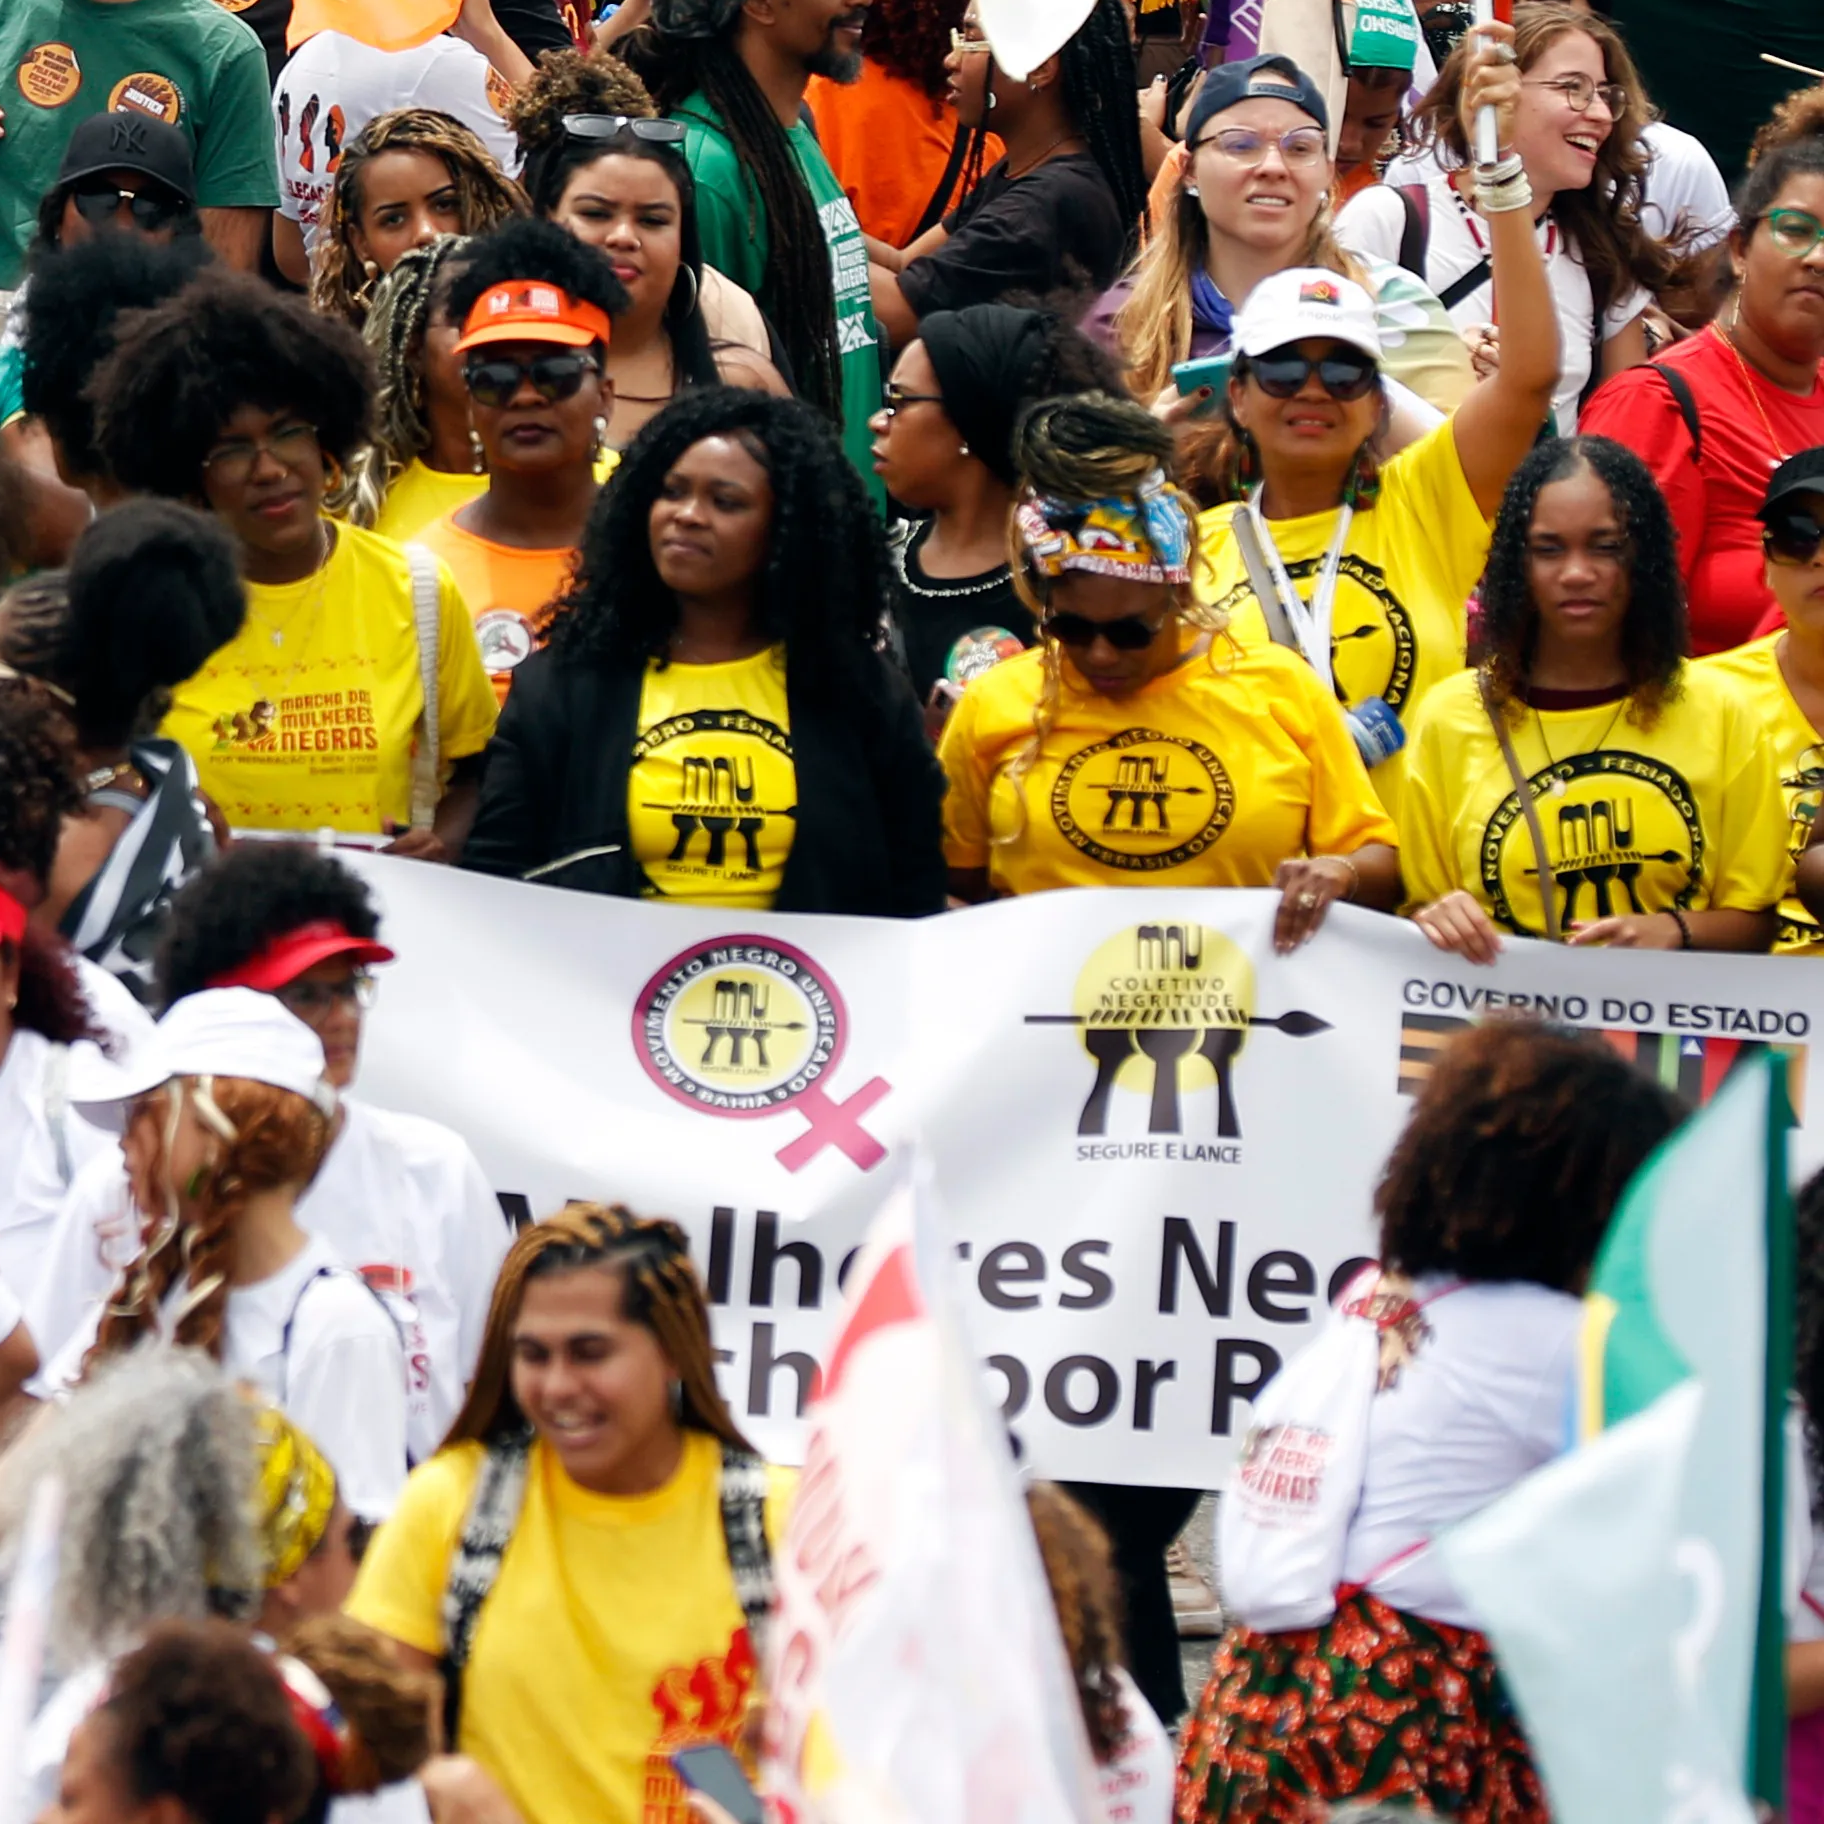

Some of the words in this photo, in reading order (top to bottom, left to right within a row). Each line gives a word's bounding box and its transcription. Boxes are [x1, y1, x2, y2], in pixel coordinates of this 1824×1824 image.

[281, 691, 344, 712] MARCHA
[280, 705, 374, 731] MULHERES
[281, 722, 381, 753] NEGRAS
[1600, 755, 1696, 820] FERIADO
[1187, 748, 1234, 855] UNIFICADO
[1101, 850, 1178, 871] BRASIL
[1108, 976, 1228, 995] COLETIVO
[1098, 992, 1237, 1011] NEGRITUDE
[1402, 978, 1590, 1024] GOVERNO
[1603, 997, 1655, 1025] DO
[1666, 1002, 1812, 1041] ESTADO
[643, 957, 706, 1098] MOVIMENTO
[711, 946, 798, 978] NEGRO
[783, 980, 837, 1096] UNIFICADO
[695, 1087, 773, 1110] BAHIA
[1074, 1141, 1163, 1163] SEGURE
[1164, 1142, 1177, 1161] E
[1179, 1143, 1244, 1166] LANCE
